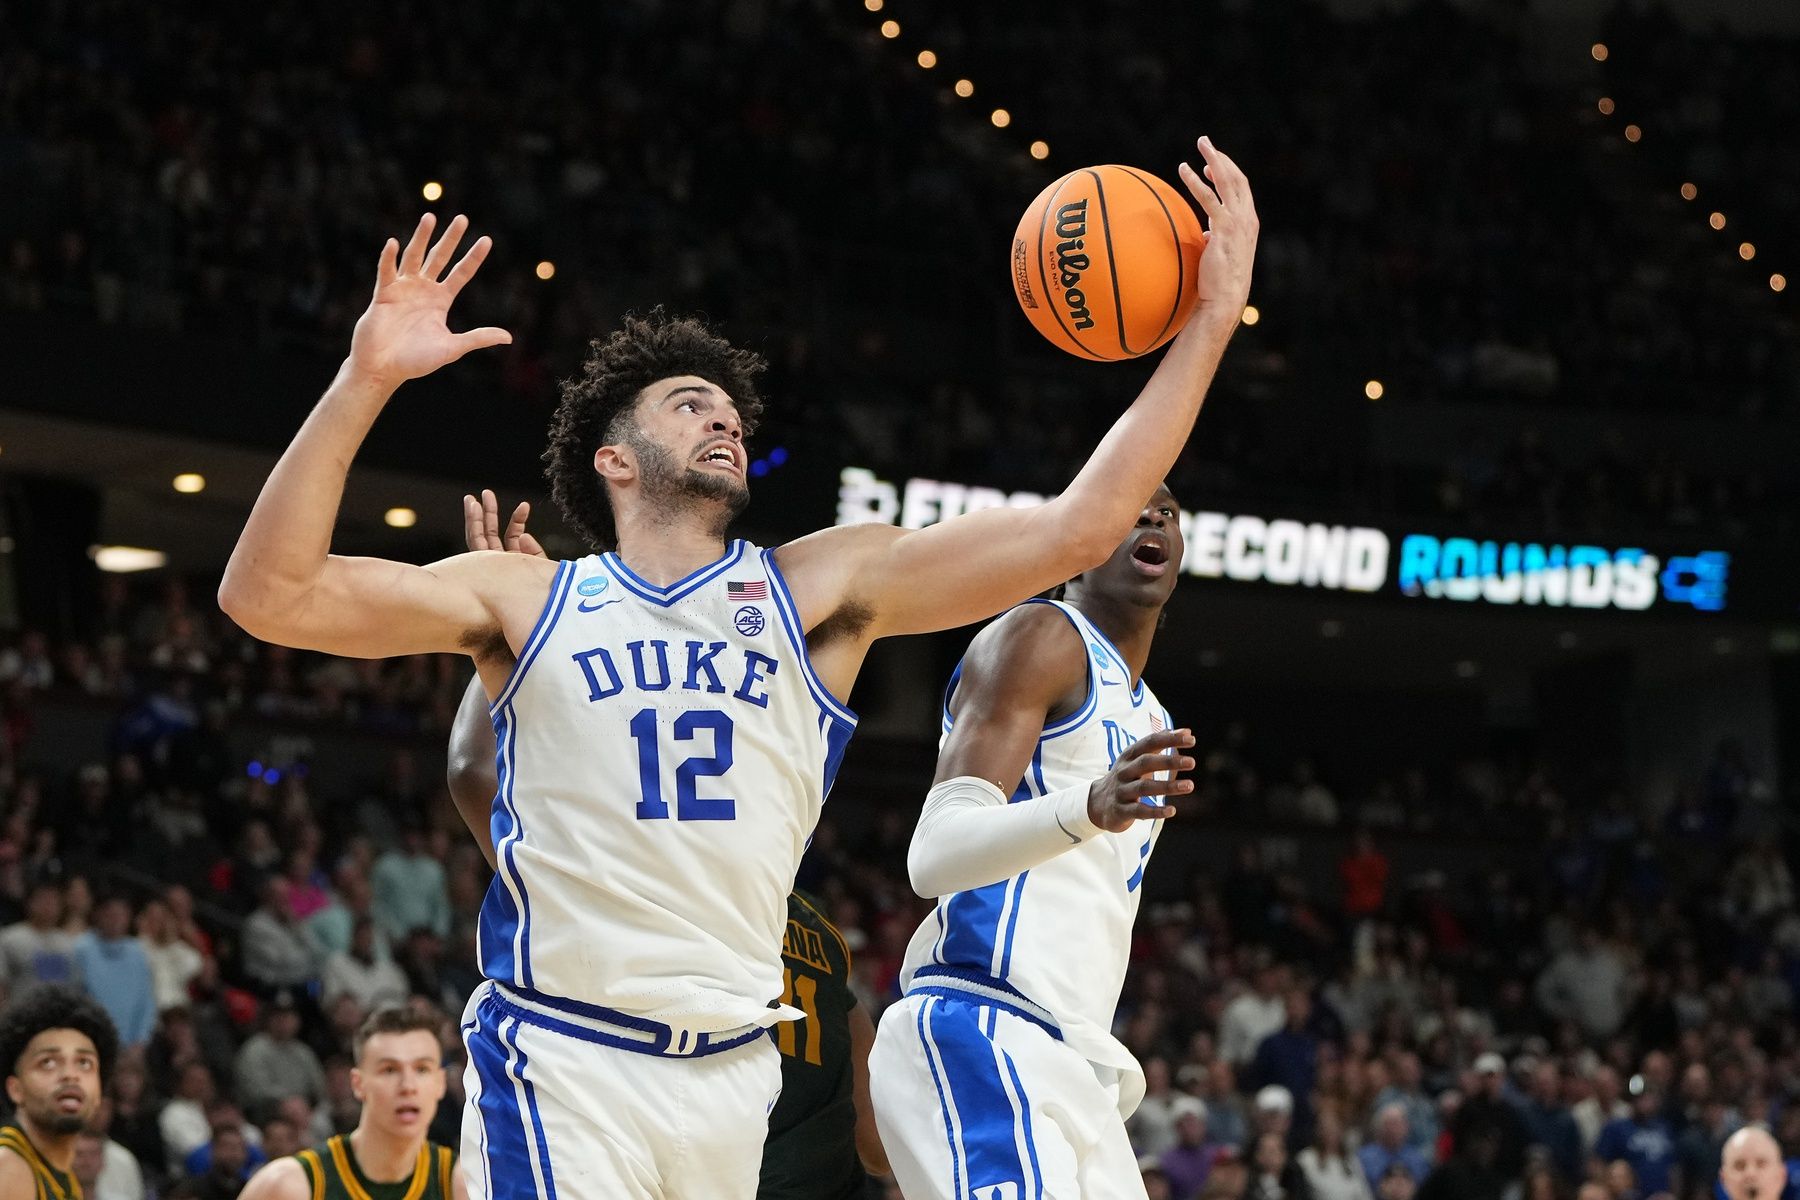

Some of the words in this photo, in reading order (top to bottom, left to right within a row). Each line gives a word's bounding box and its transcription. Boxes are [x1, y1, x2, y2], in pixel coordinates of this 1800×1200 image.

[1052, 272, 1061, 292] NXT
[1055, 198, 1095, 331] Wilson
[1400, 534, 1660, 611] ROUNDS
[572, 640, 778, 709] DUKE
[630, 709, 736, 821] 12
